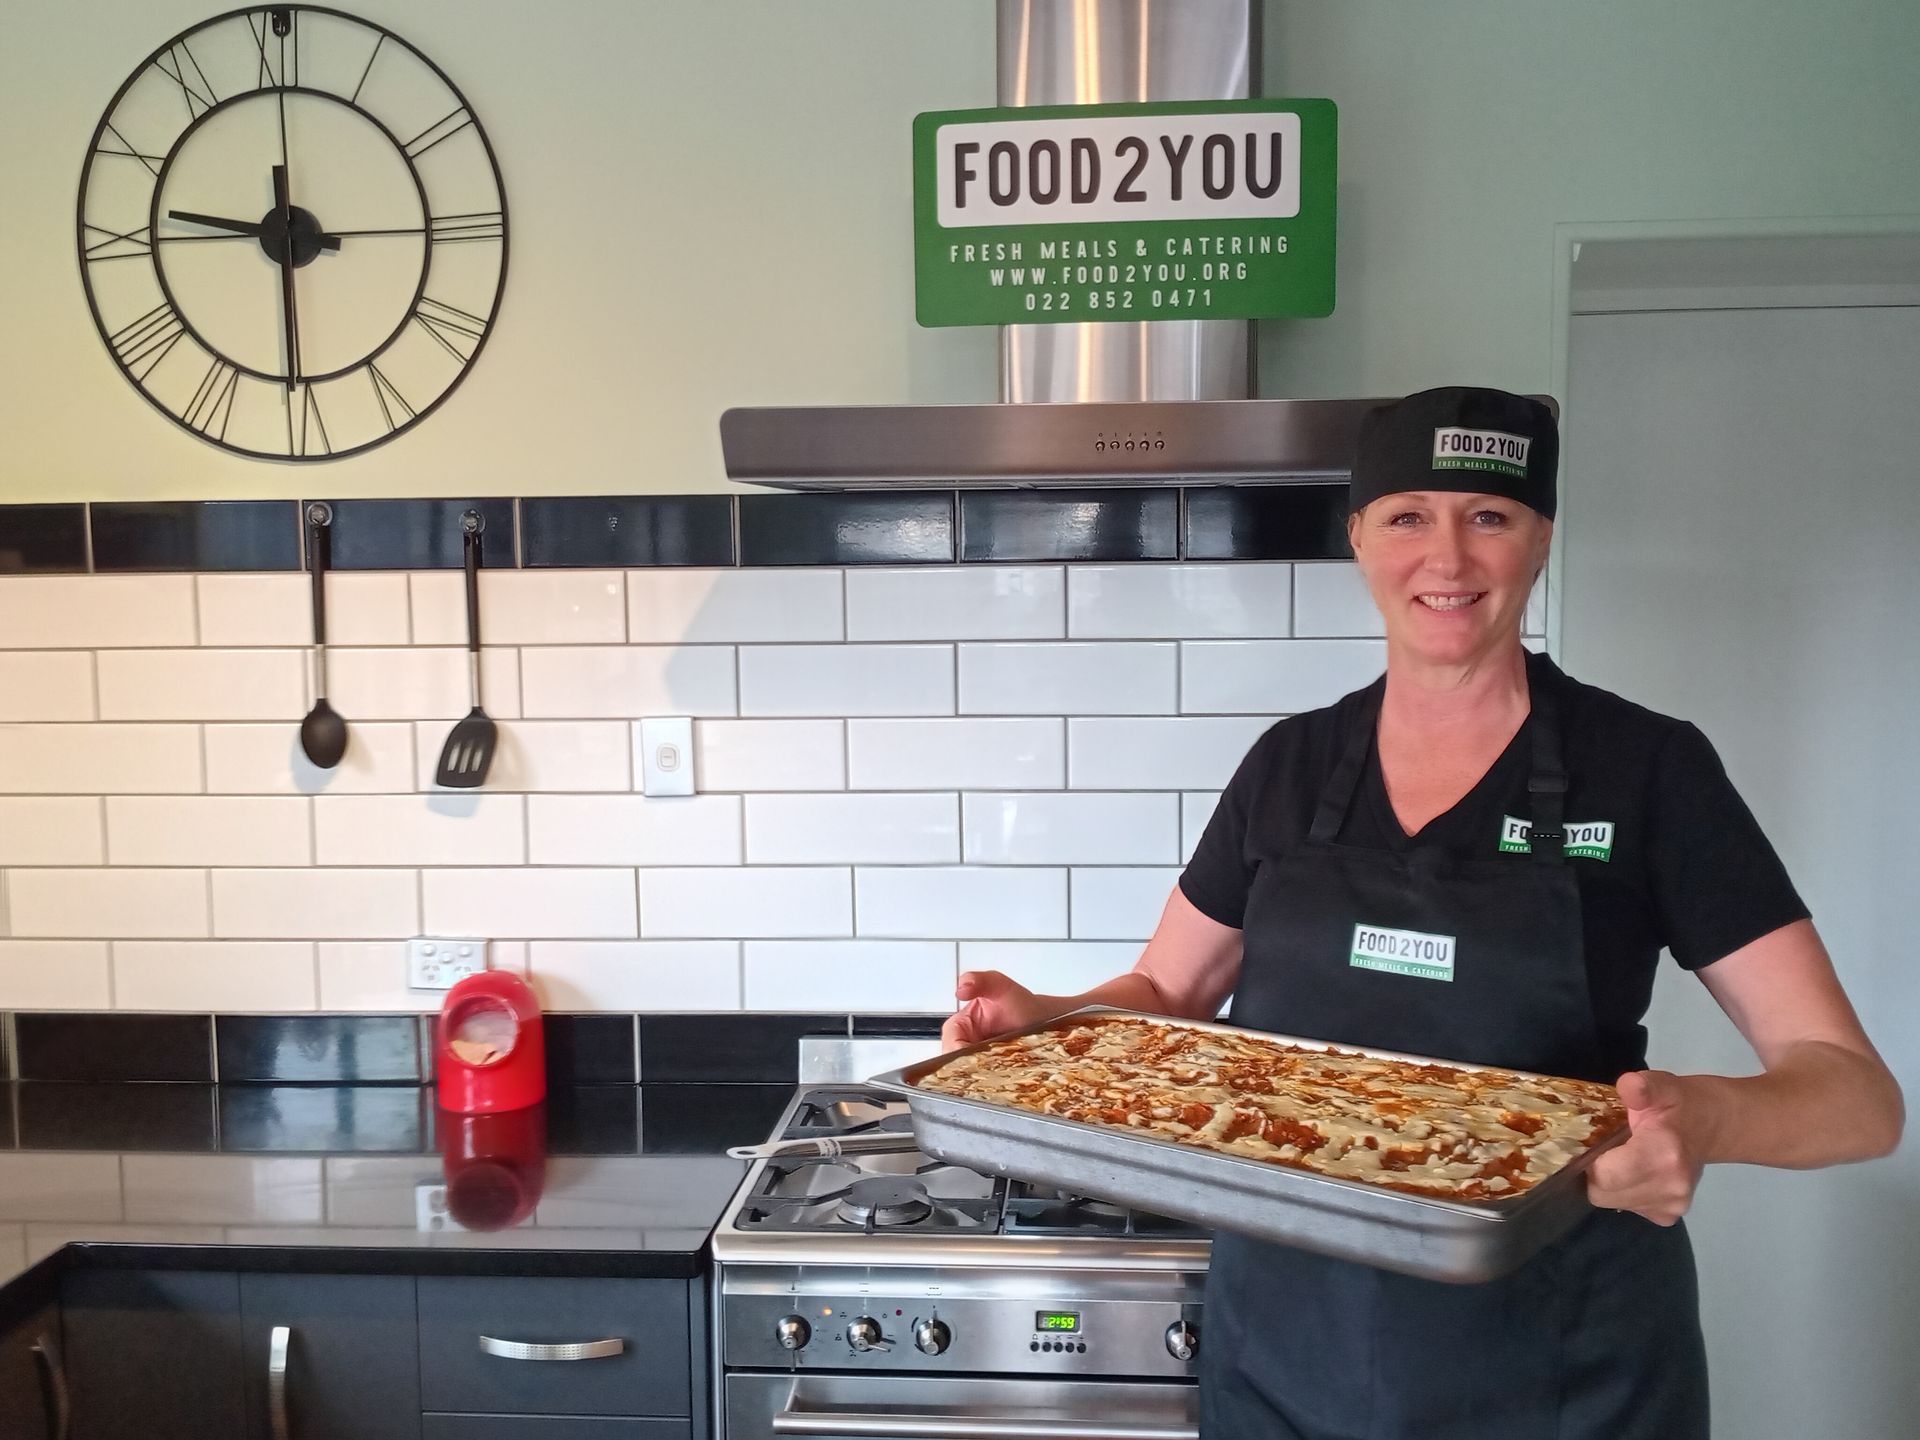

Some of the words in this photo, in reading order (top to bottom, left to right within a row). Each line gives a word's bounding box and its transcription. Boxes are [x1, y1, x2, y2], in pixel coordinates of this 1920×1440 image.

[954, 132, 1283, 208] FOOD2YOU
[950, 243, 1022, 263] FRESH
[1040, 240, 1117, 260] MEALS
[1135, 239, 1147, 257] &
[1166, 236, 1288, 256] CATERING
[990, 262, 1247, 286] WWW.FOOD2YOU.ORG
[1025, 292, 1071, 311] 022
[1089, 291, 1133, 309] 852
[1152, 289, 1211, 307] 0471
[1441, 433, 1525, 460] FOOD2YOU
[1464, 461, 1487, 469] MEALS
[1568, 848, 1605, 858] CATERING
[1358, 931, 1448, 961] FOOD2YOU
[1412, 967, 1449, 979] CATERING
